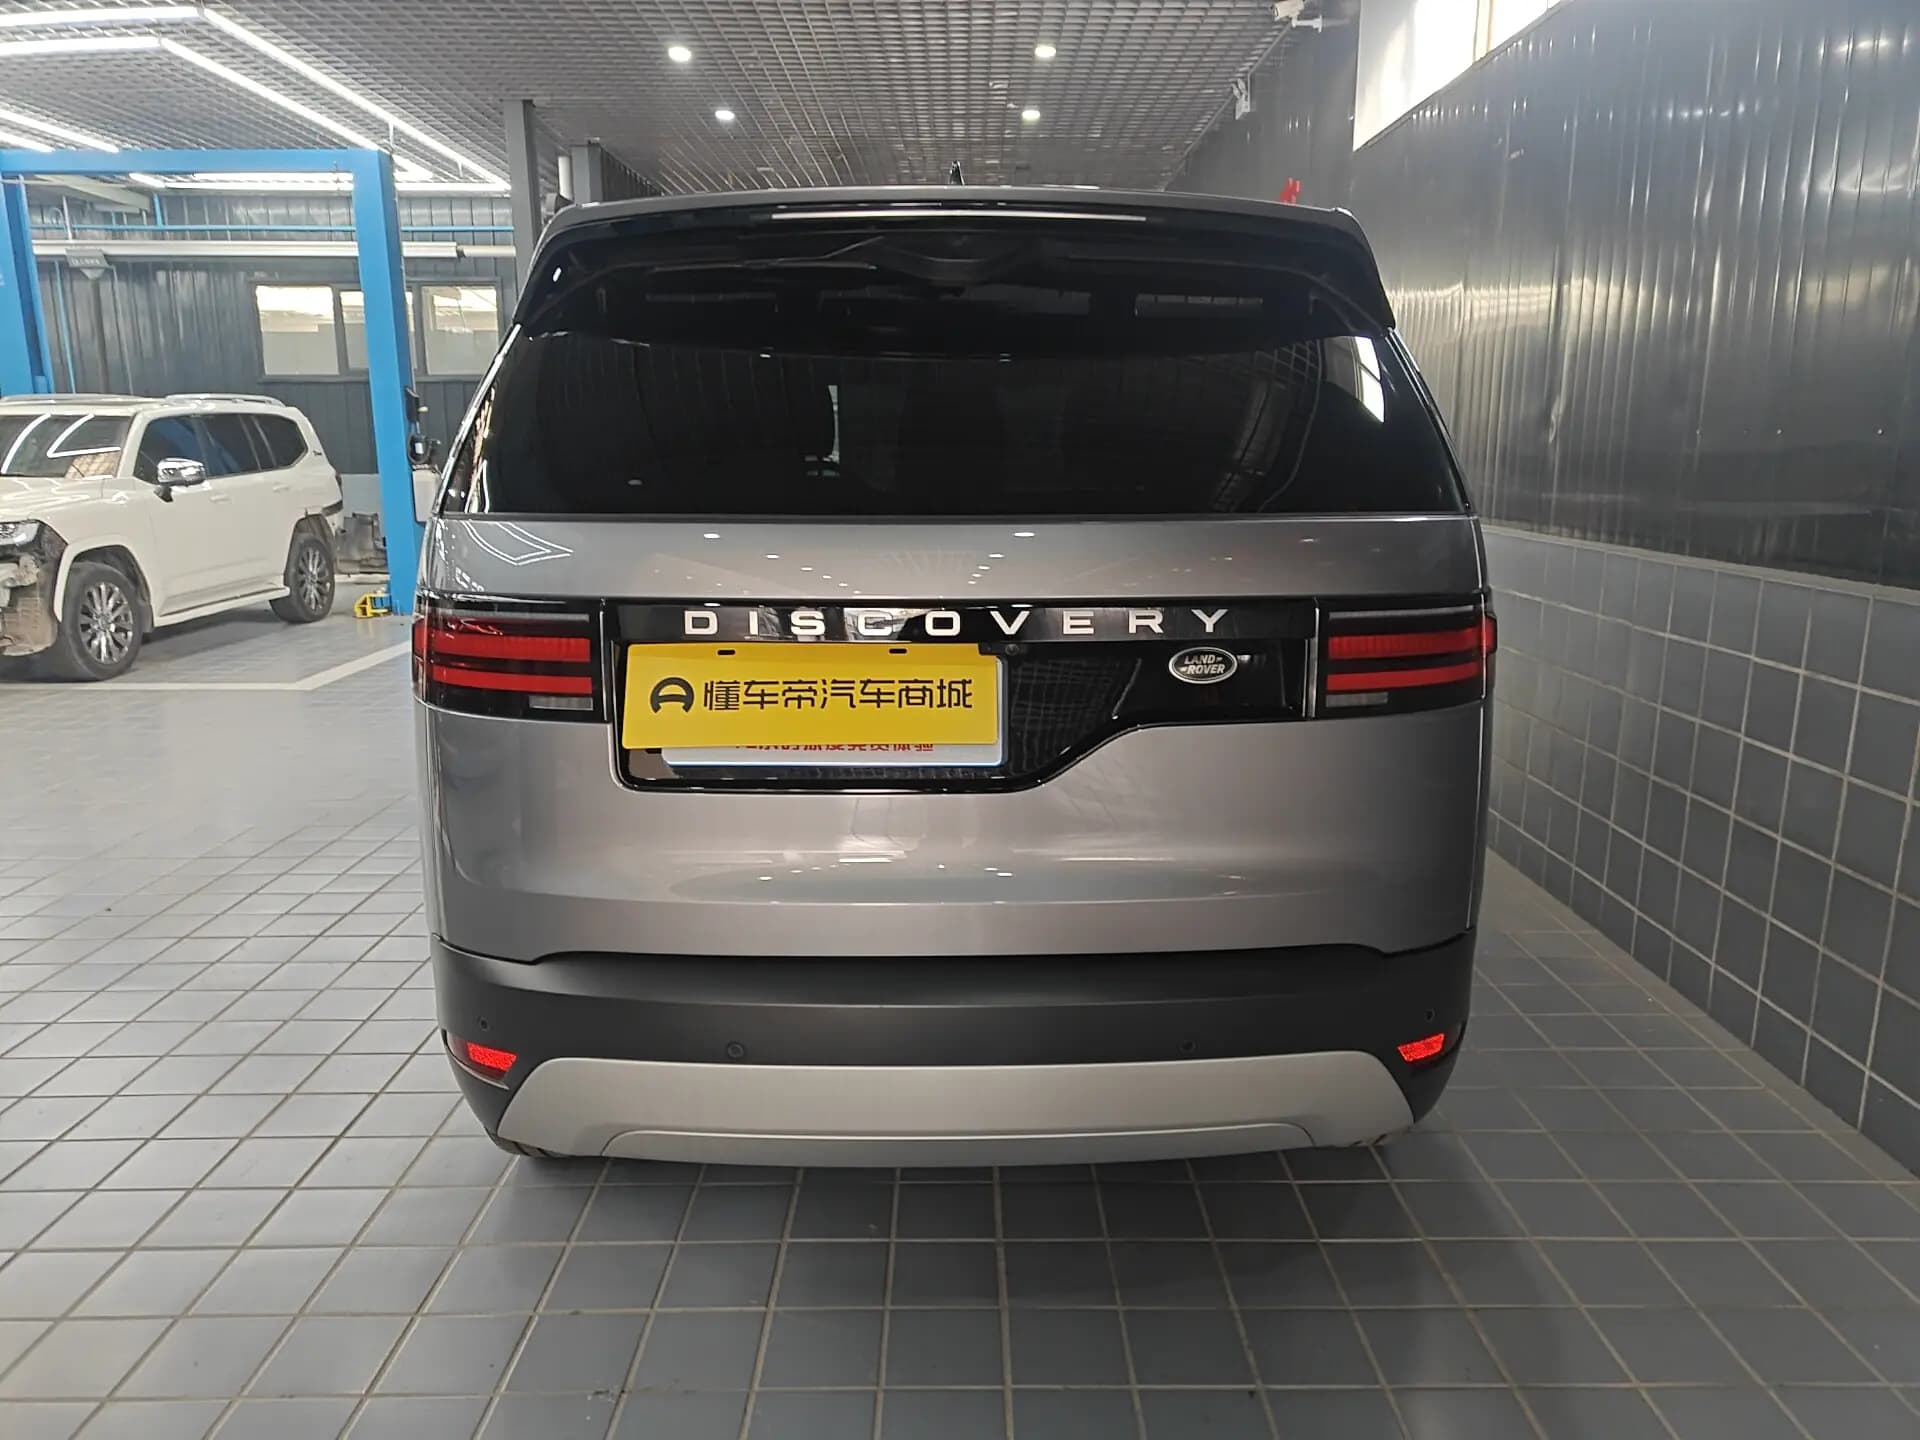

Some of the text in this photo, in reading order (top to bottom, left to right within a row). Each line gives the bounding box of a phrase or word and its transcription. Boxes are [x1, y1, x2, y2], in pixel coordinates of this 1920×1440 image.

[684, 608, 1229, 636] DISCOVERY
[703, 678, 973, 711] 懂车帝汽车商城
